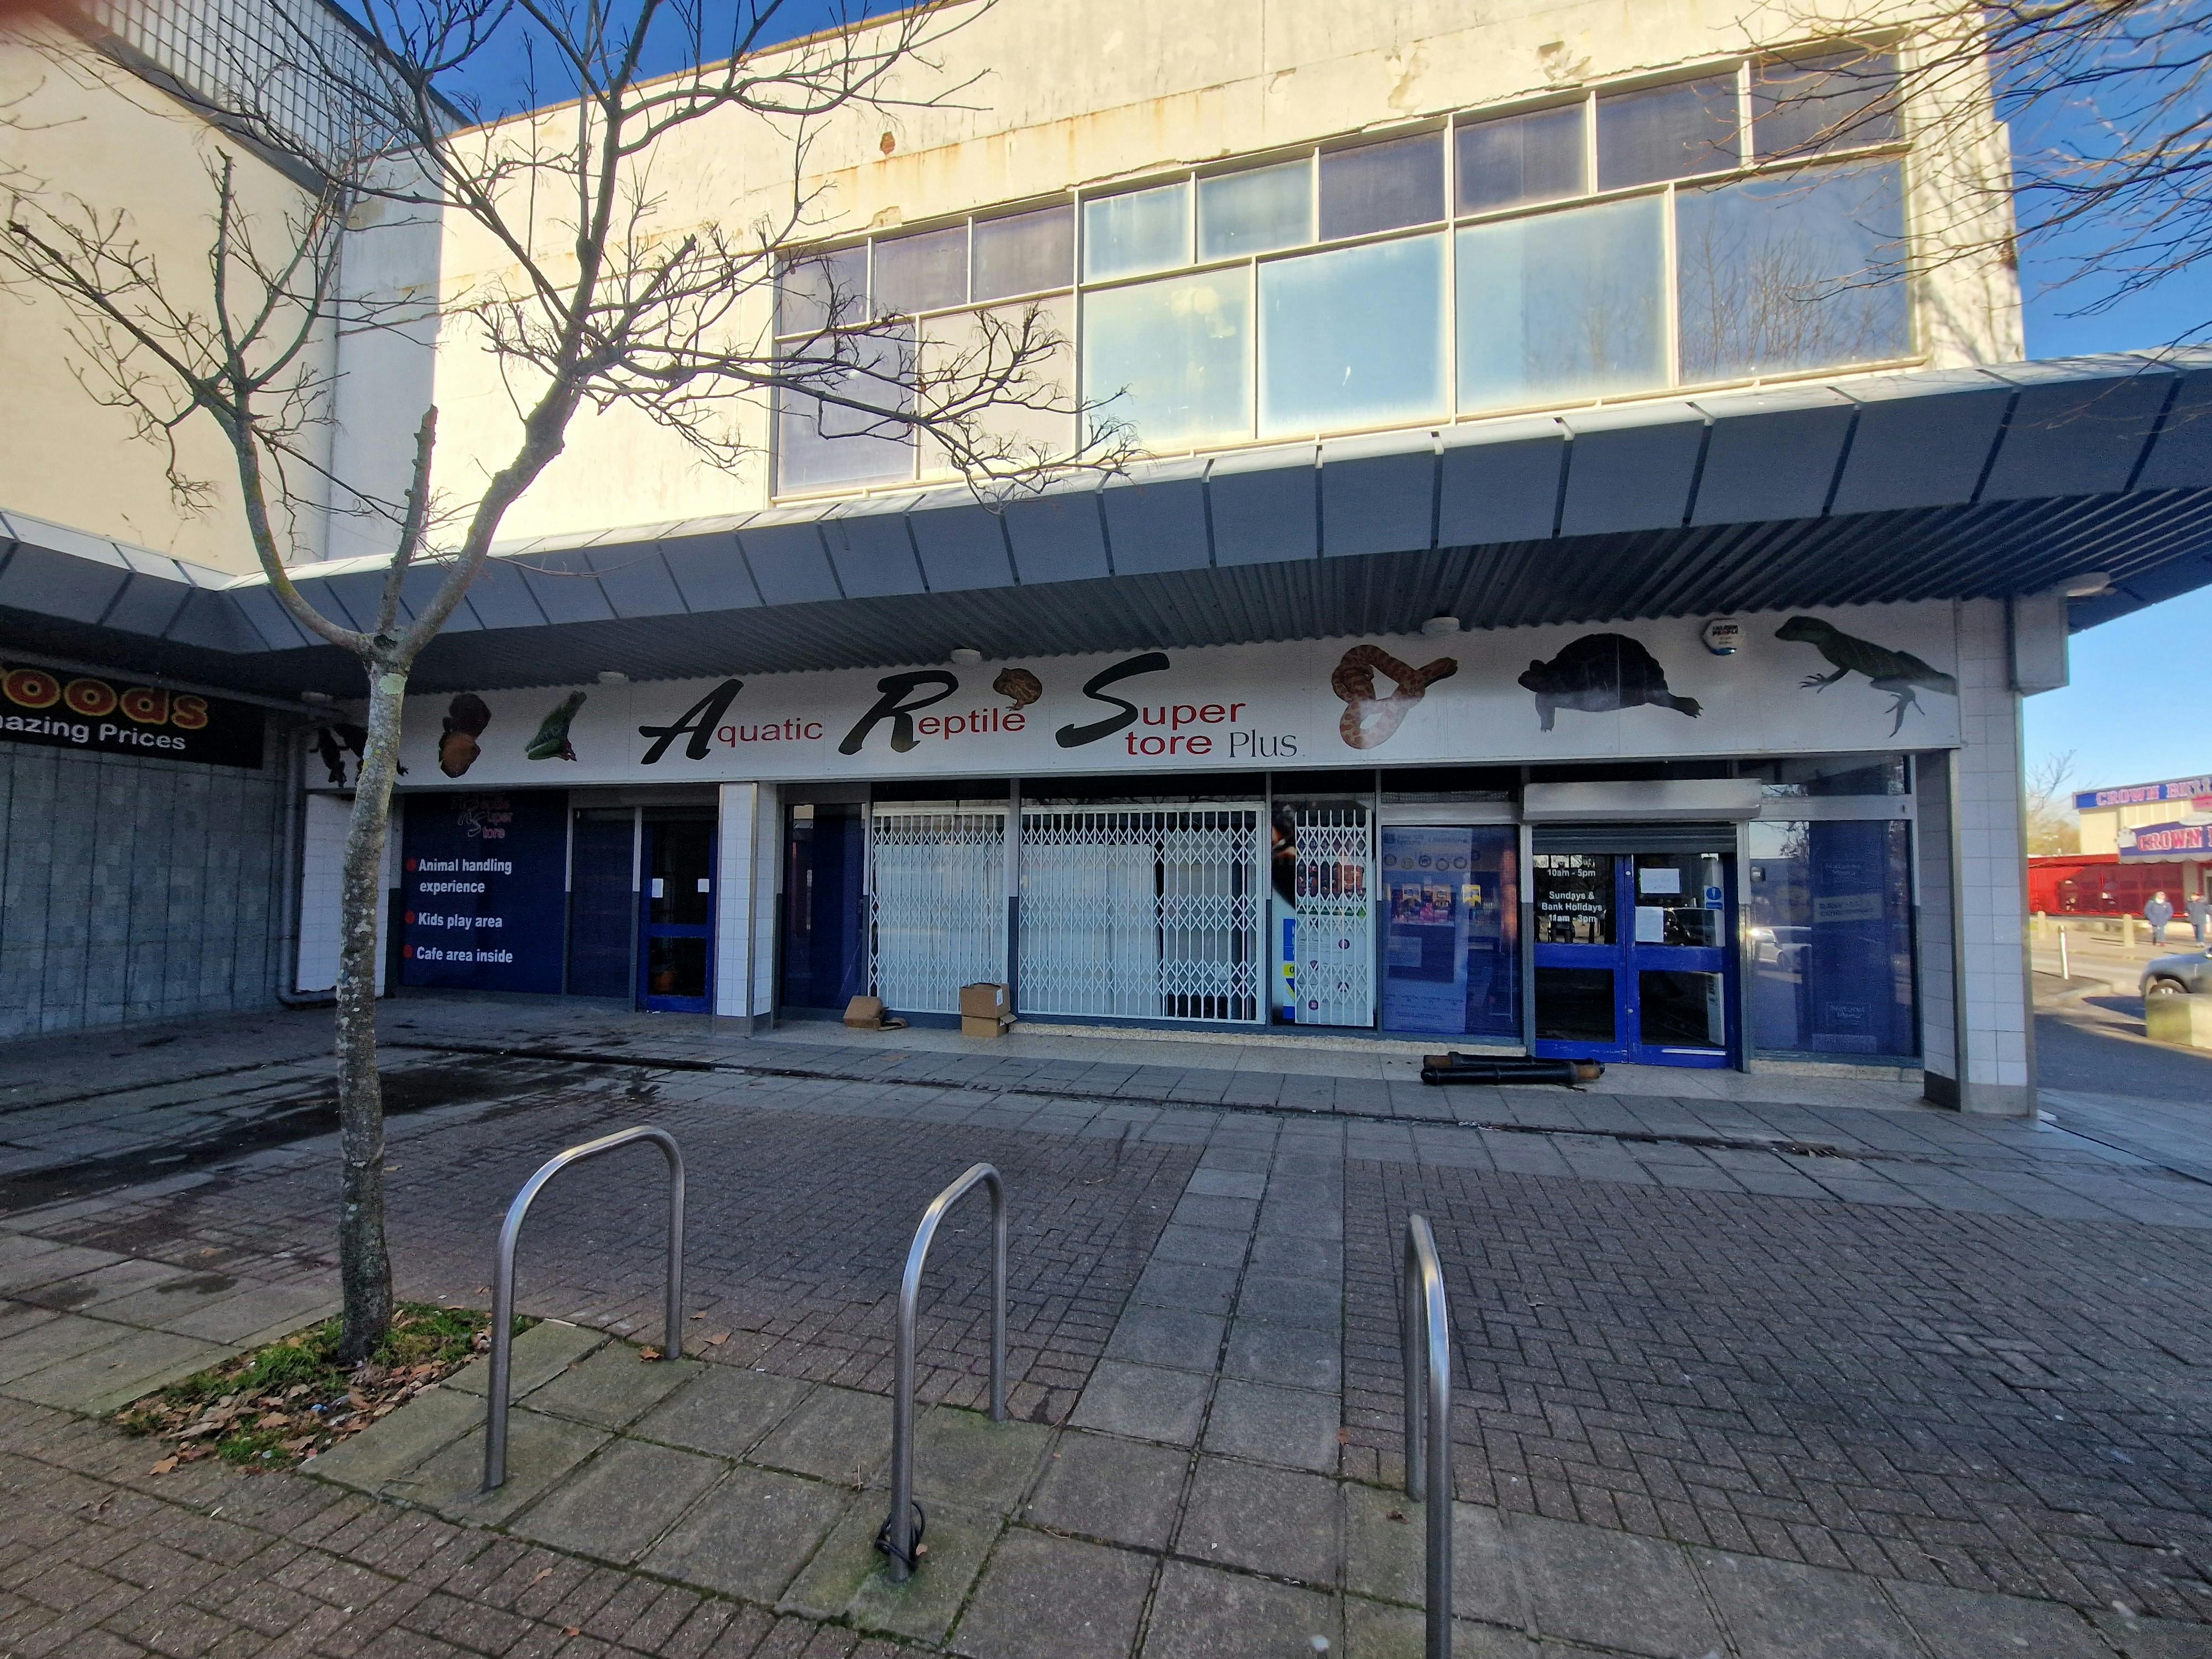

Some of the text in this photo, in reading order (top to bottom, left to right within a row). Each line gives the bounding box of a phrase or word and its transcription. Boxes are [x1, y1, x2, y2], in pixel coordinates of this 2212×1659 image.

[0, 667, 208, 729] oods
[639, 679, 823, 765] Aquatic
[838, 670, 1026, 755] Reptile
[99, 723, 186, 750] Prices
[1229, 728, 1298, 758] Plus
[2096, 785, 2159, 806] CROWN
[2138, 826, 2203, 851] CROWN
[419, 858, 512, 875] Animal handling
[1577, 868, 1596, 878] 5pm
[420, 880, 485, 895] experience
[1549, 891, 1595, 901] Sundays &
[1565, 902, 1603, 912] Holidays
[418, 912, 503, 930] Kids play area
[417, 947, 513, 963] Cafe area inside
